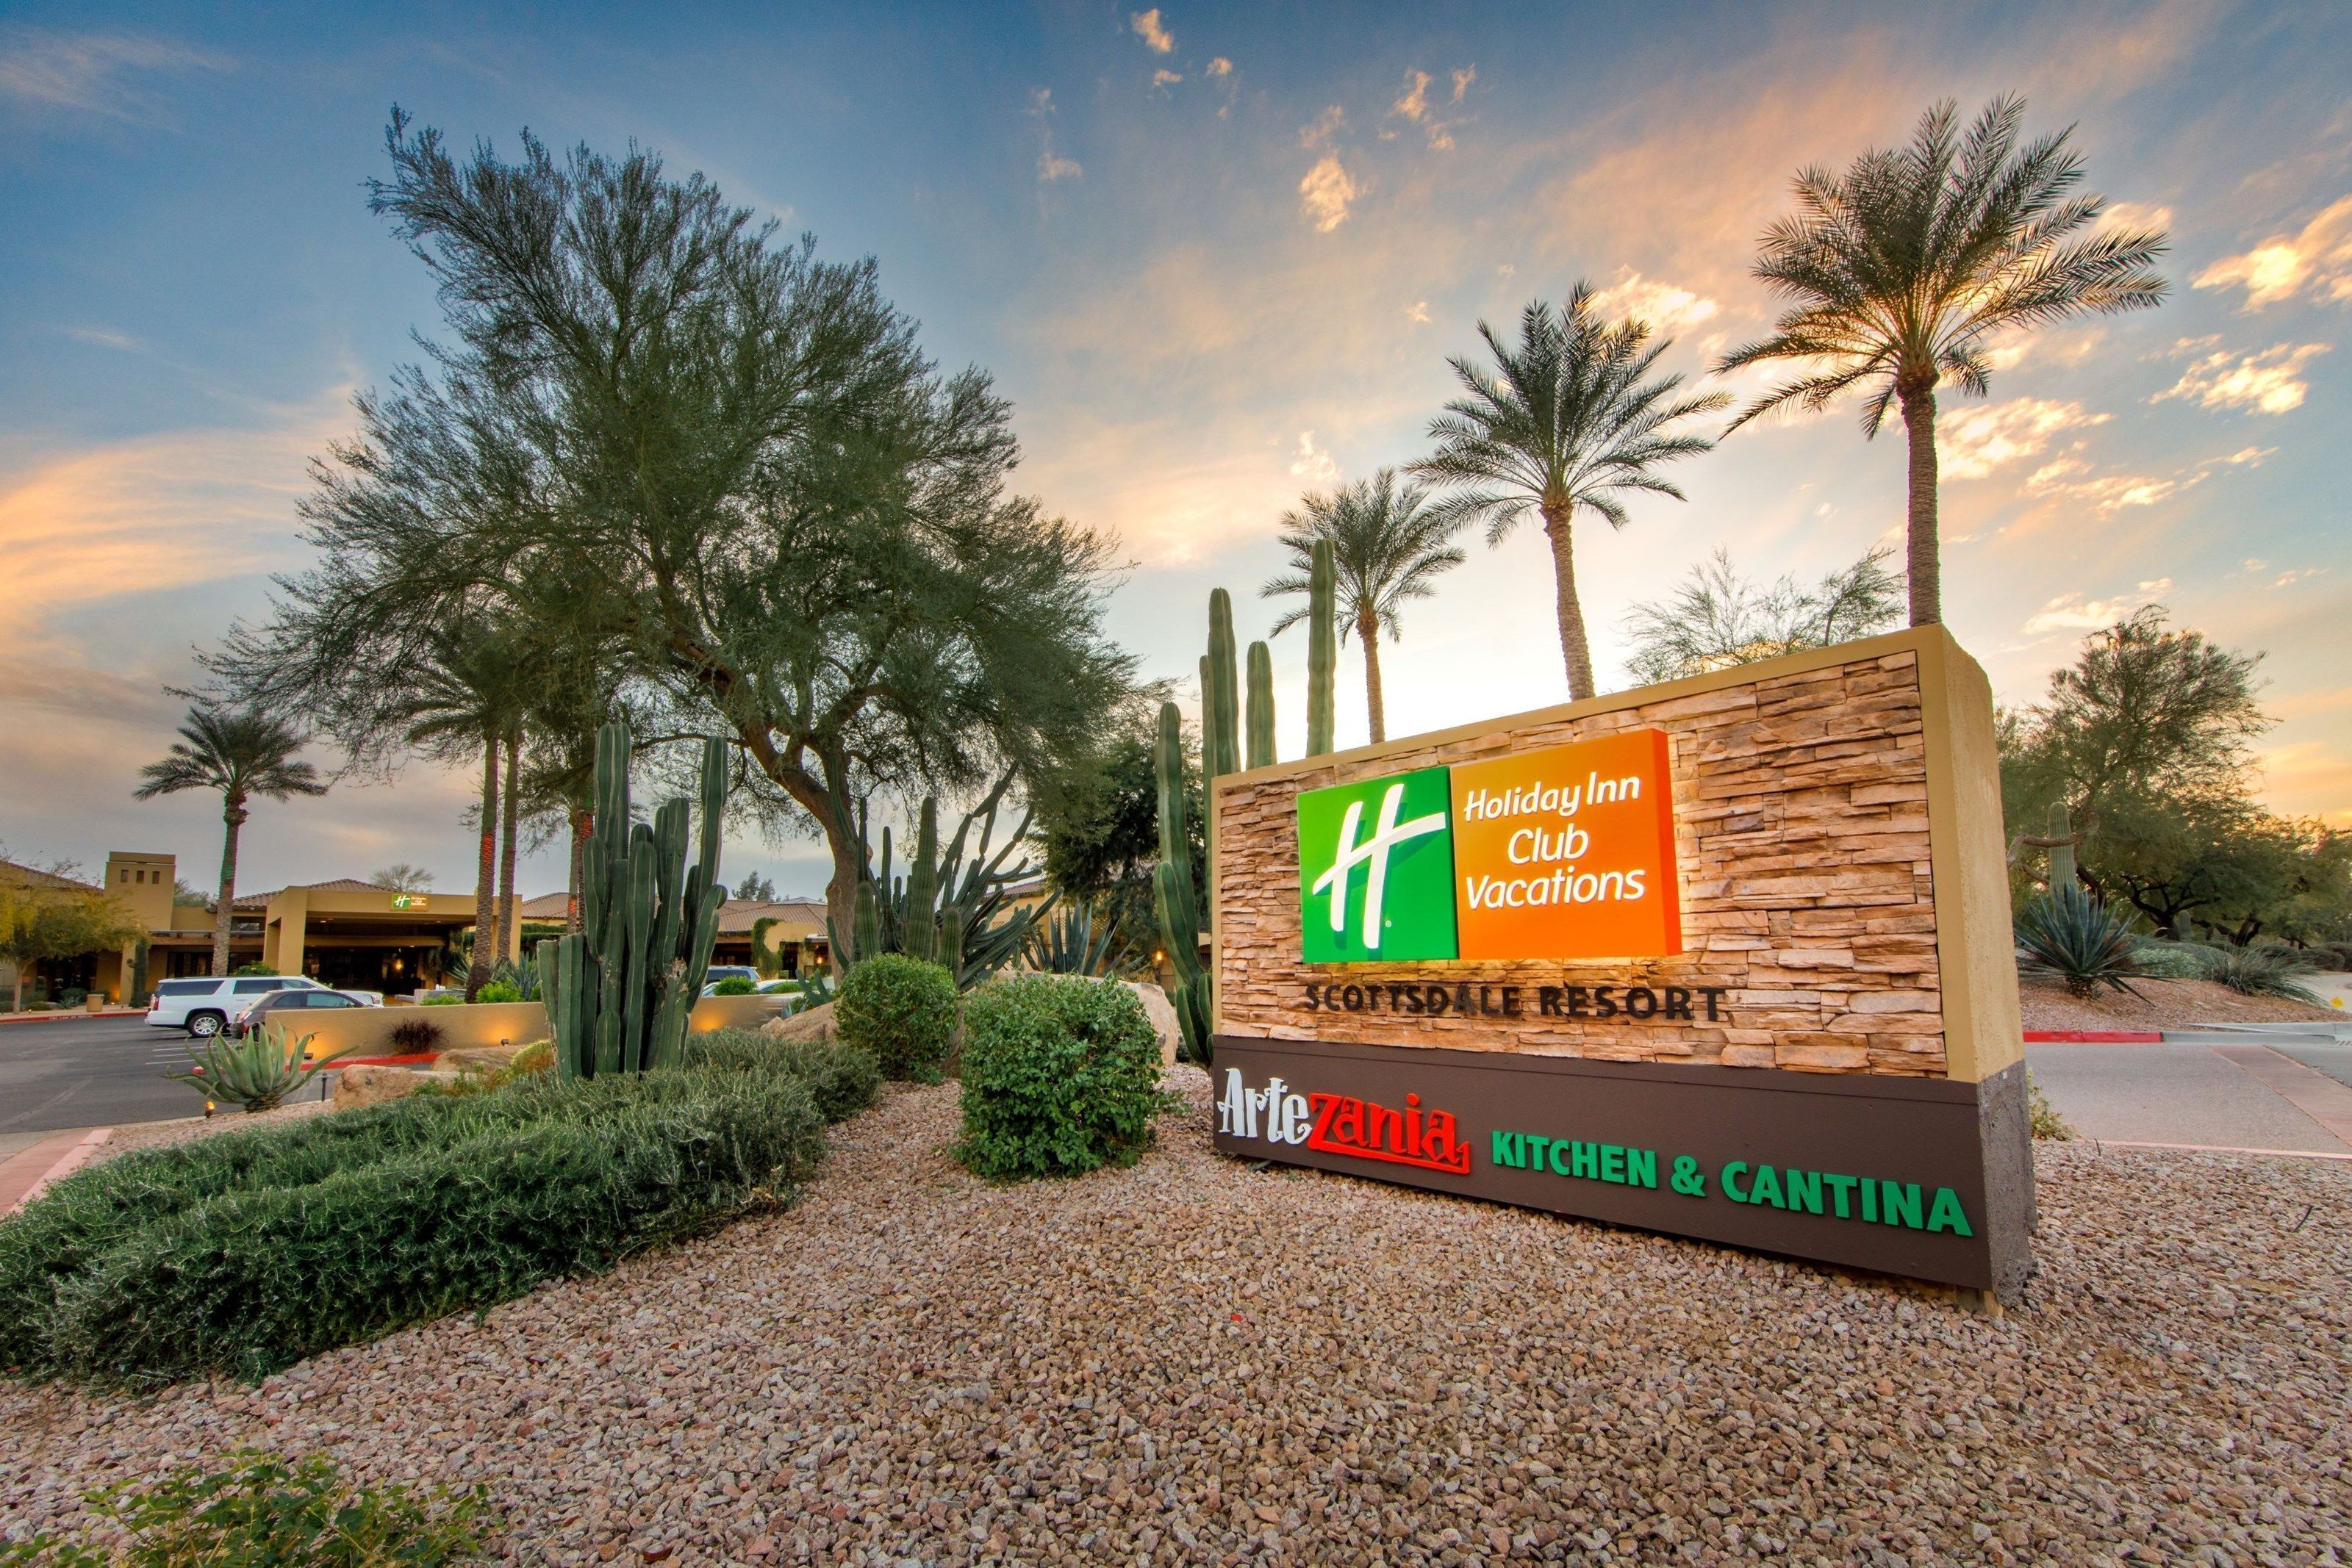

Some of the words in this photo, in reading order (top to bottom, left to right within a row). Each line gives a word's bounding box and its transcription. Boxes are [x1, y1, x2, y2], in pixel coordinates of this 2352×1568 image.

[1464, 782, 1580, 821] Holiday
[1587, 771, 1641, 805] Inn
[1508, 823, 1589, 864] Club
[1466, 868, 1646, 909] Vacations
[1305, 983, 1521, 1016] SCOTTSDALE
[1538, 985, 1727, 1021] RESORT
[1491, 1129, 1657, 1189] KITCHEN
[1670, 1155, 1707, 1198] &
[1720, 1160, 1973, 1237] CANTINA
